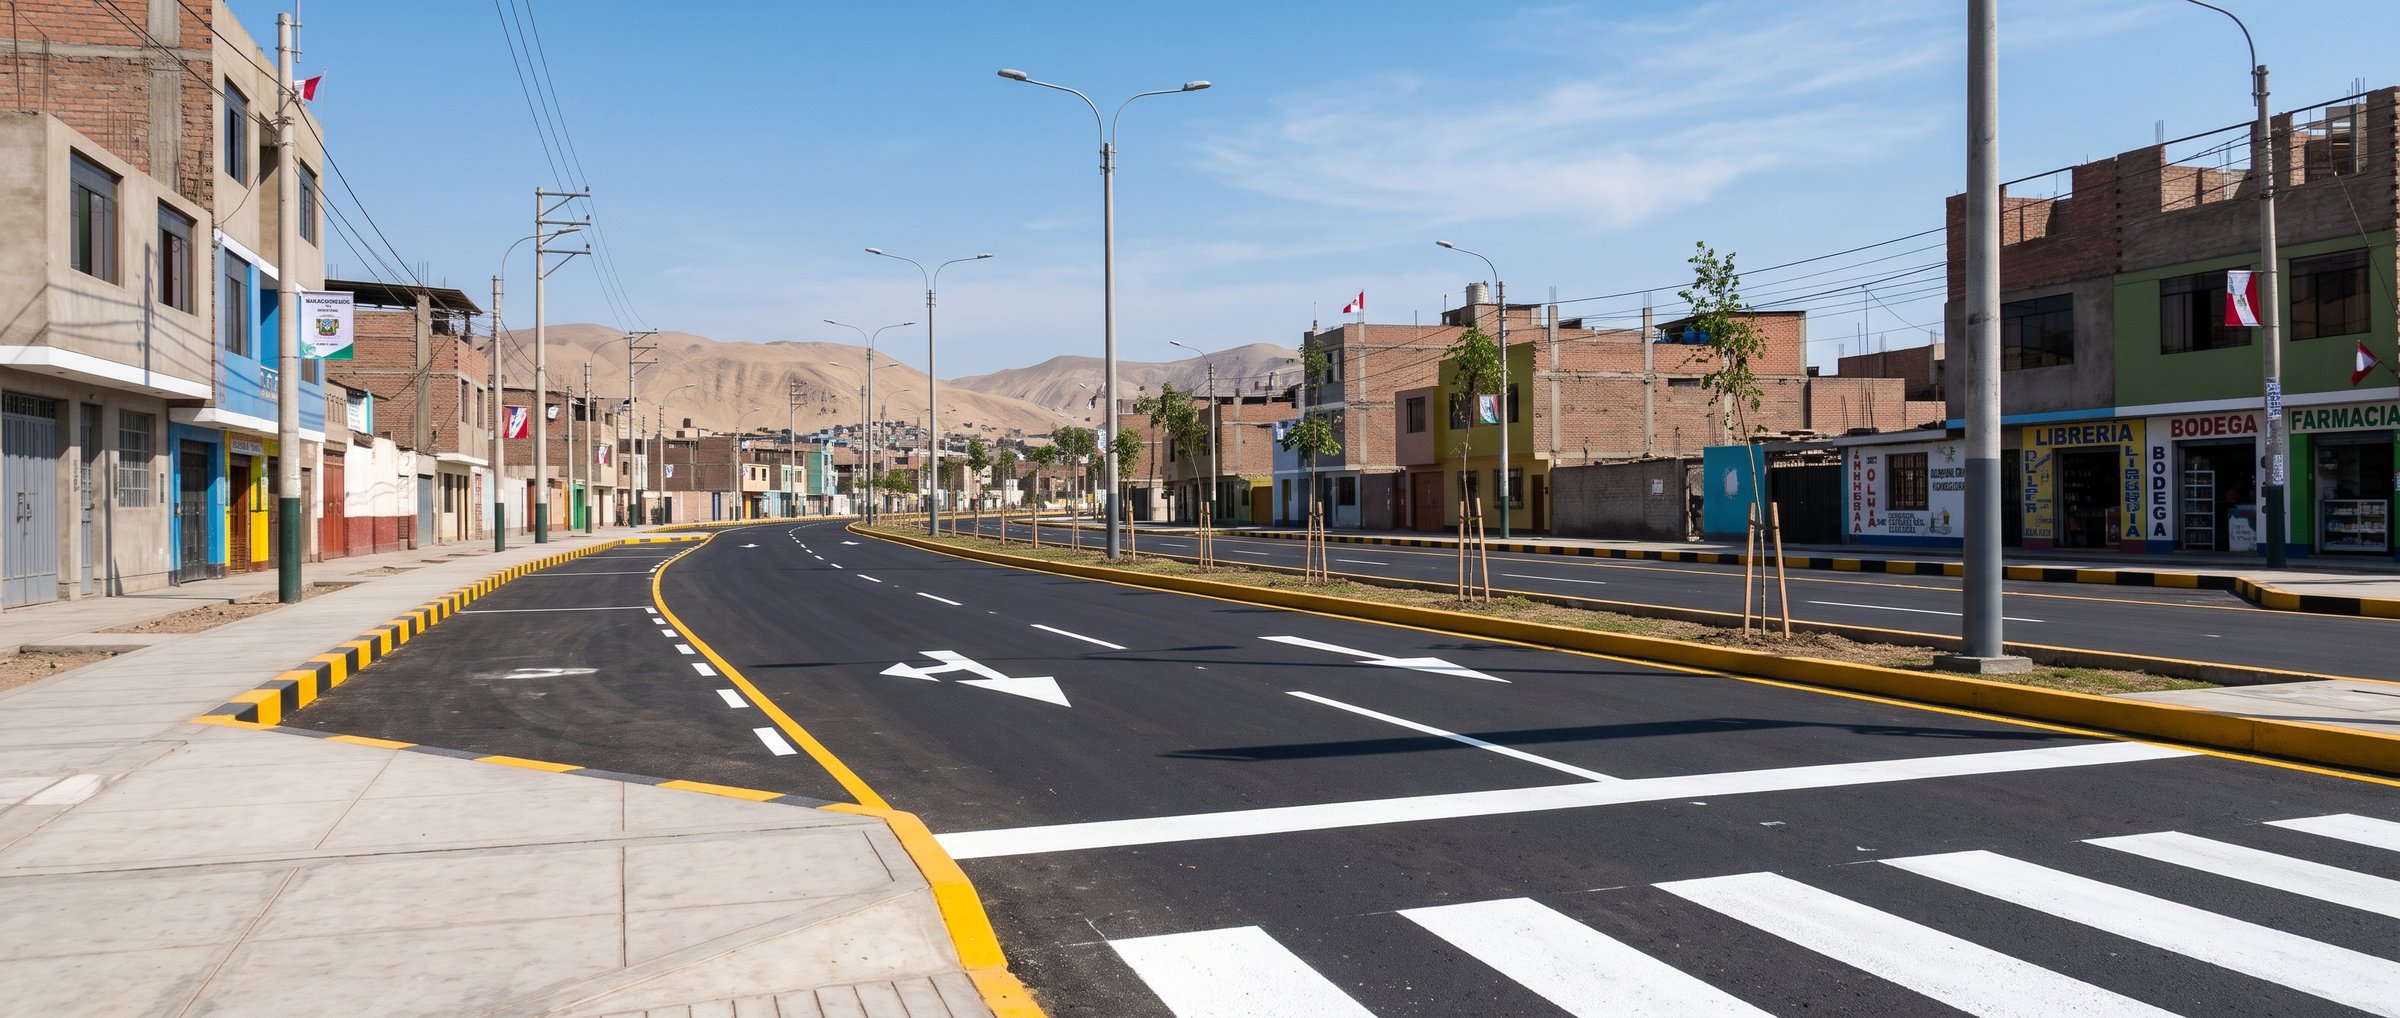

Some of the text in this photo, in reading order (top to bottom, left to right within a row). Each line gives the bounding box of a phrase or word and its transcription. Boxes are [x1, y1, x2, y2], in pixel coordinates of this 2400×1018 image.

[2170, 414, 2258, 437] BODEGA
[2291, 404, 2400, 430] FARMACIA
[2035, 420, 2134, 446] LIBRERÍA
[2152, 446, 2167, 536] BODEGA
